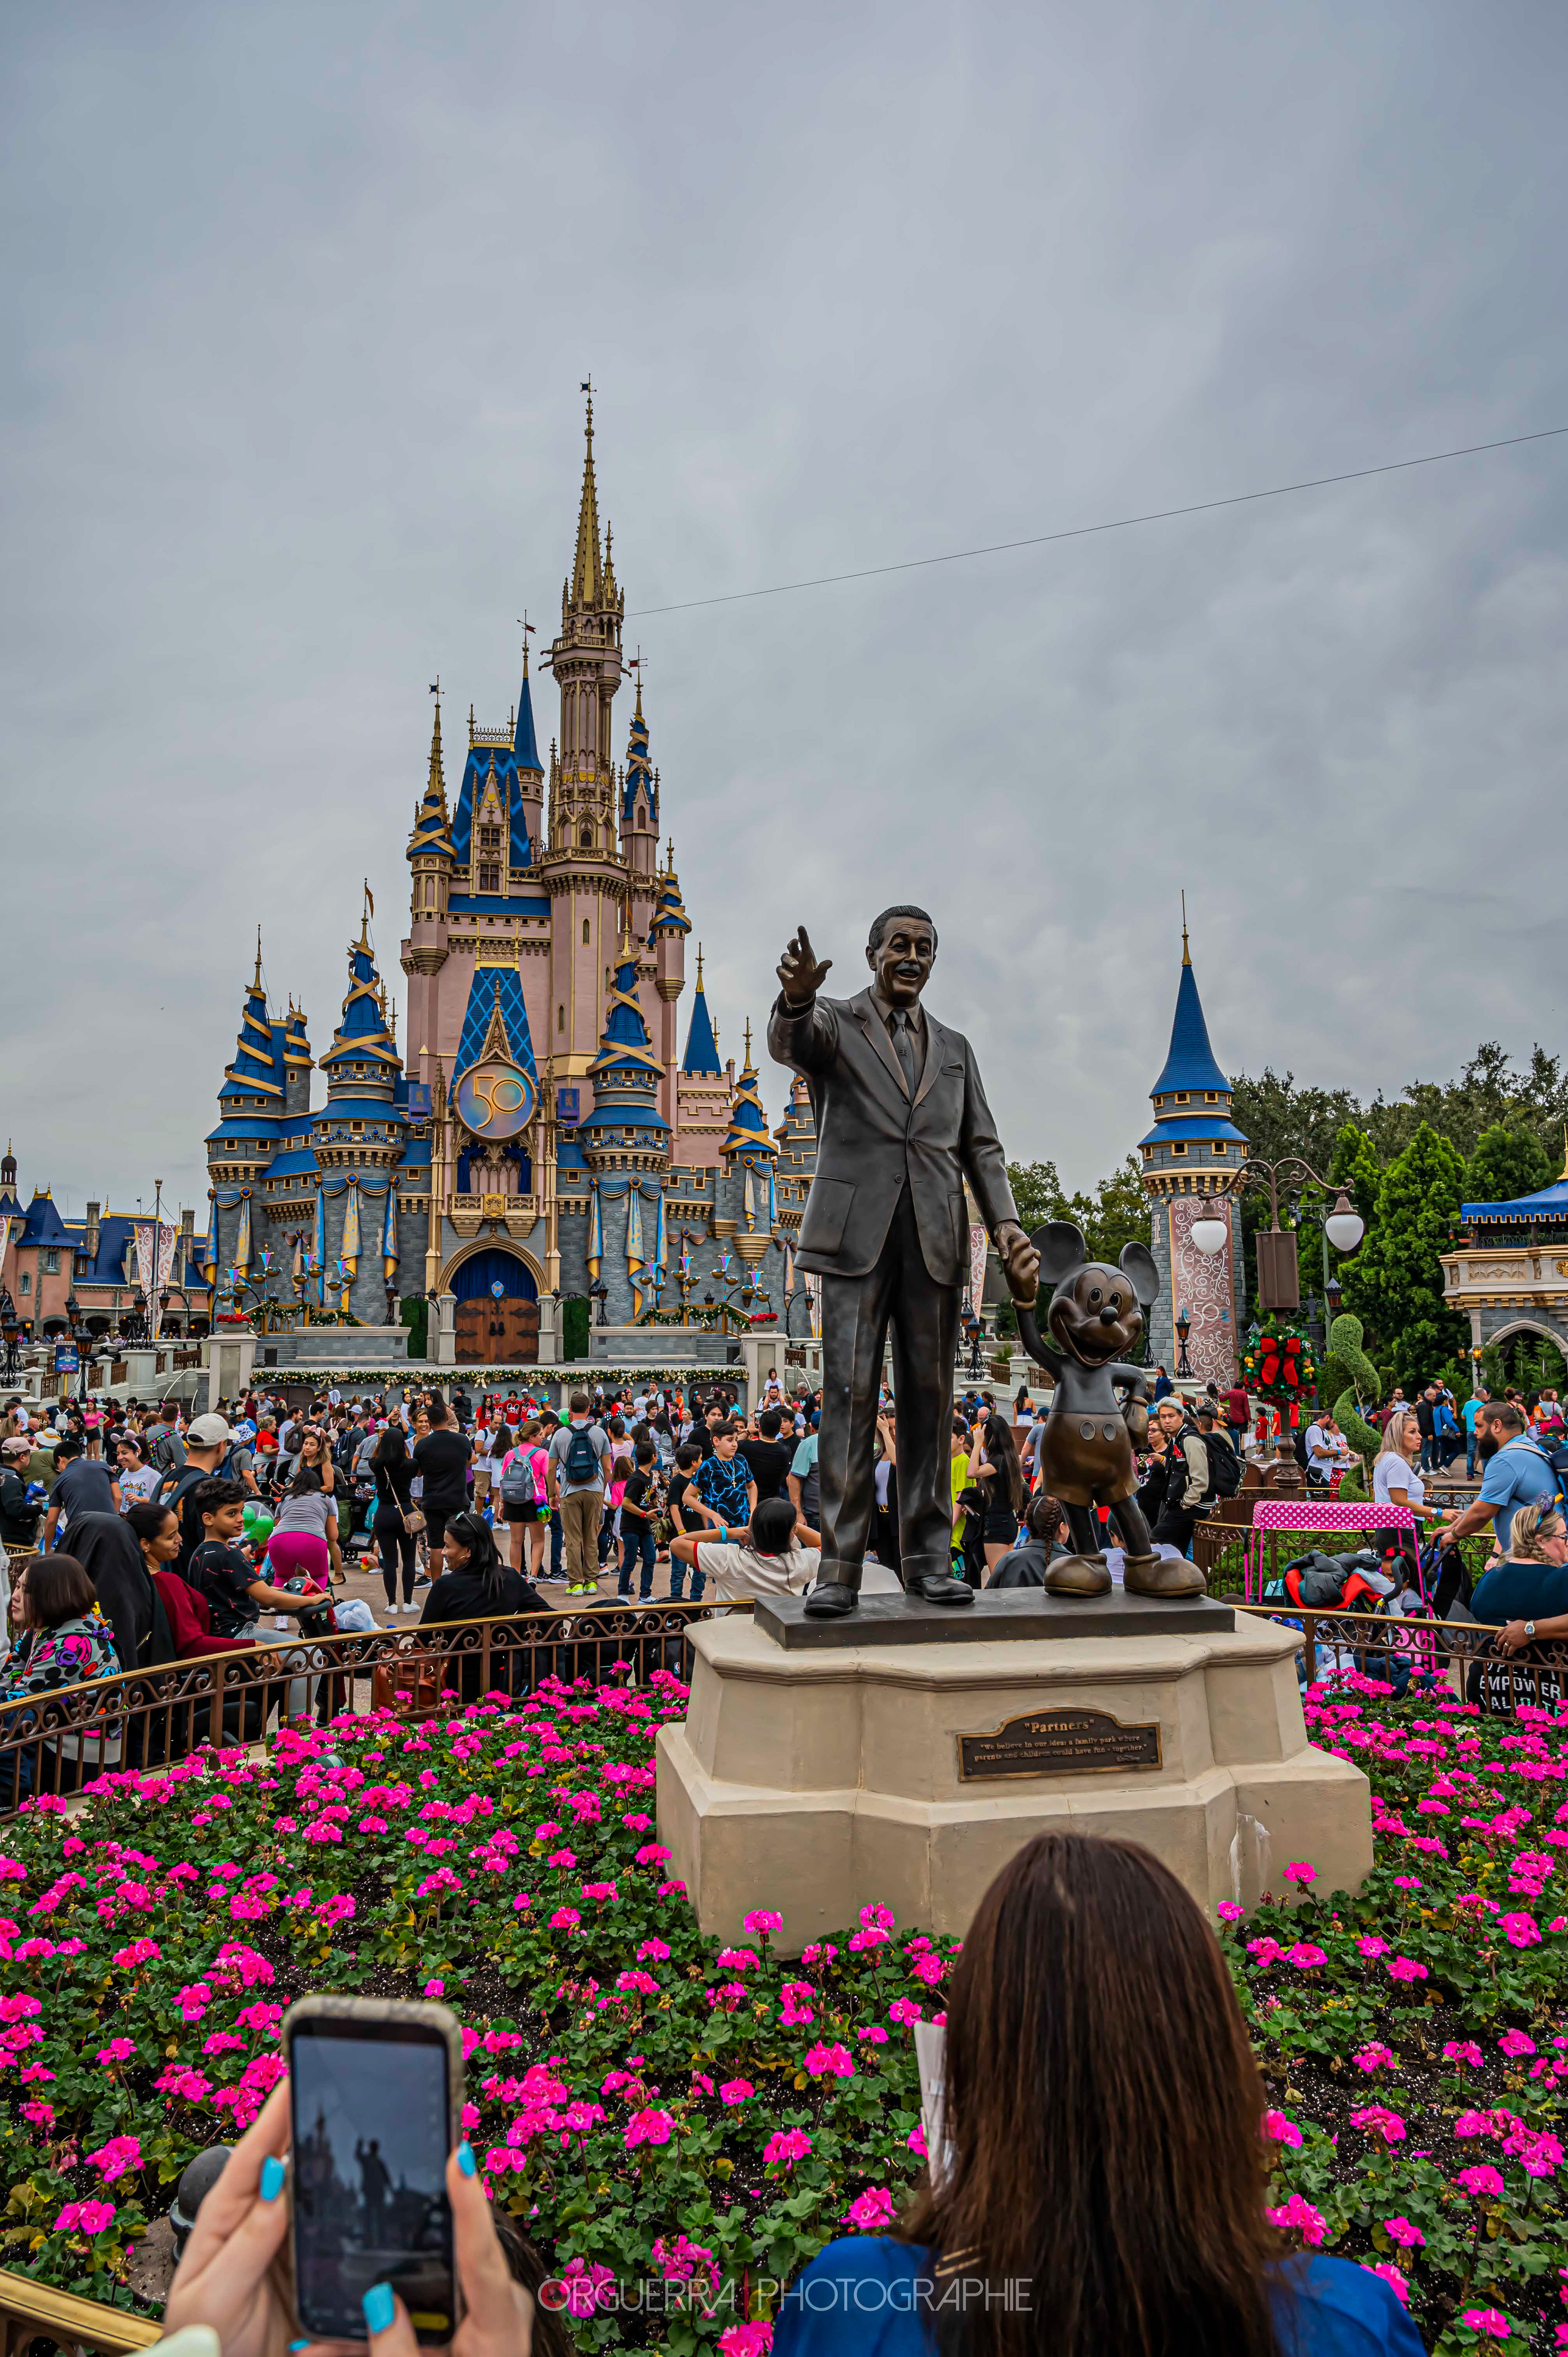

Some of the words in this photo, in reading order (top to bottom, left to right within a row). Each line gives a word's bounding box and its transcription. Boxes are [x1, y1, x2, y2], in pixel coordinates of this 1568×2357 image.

[474, 1075, 526, 1129] 50
[1193, 1302, 1219, 1330] 50
[1480, 1675, 1561, 1700] EMPOWER
[997, 1742, 1022, 1750] believe
[1075, 1737, 1098, 1745] family
[1100, 1736, 1116, 1744] park
[974, 1755, 1002, 1763] parents
